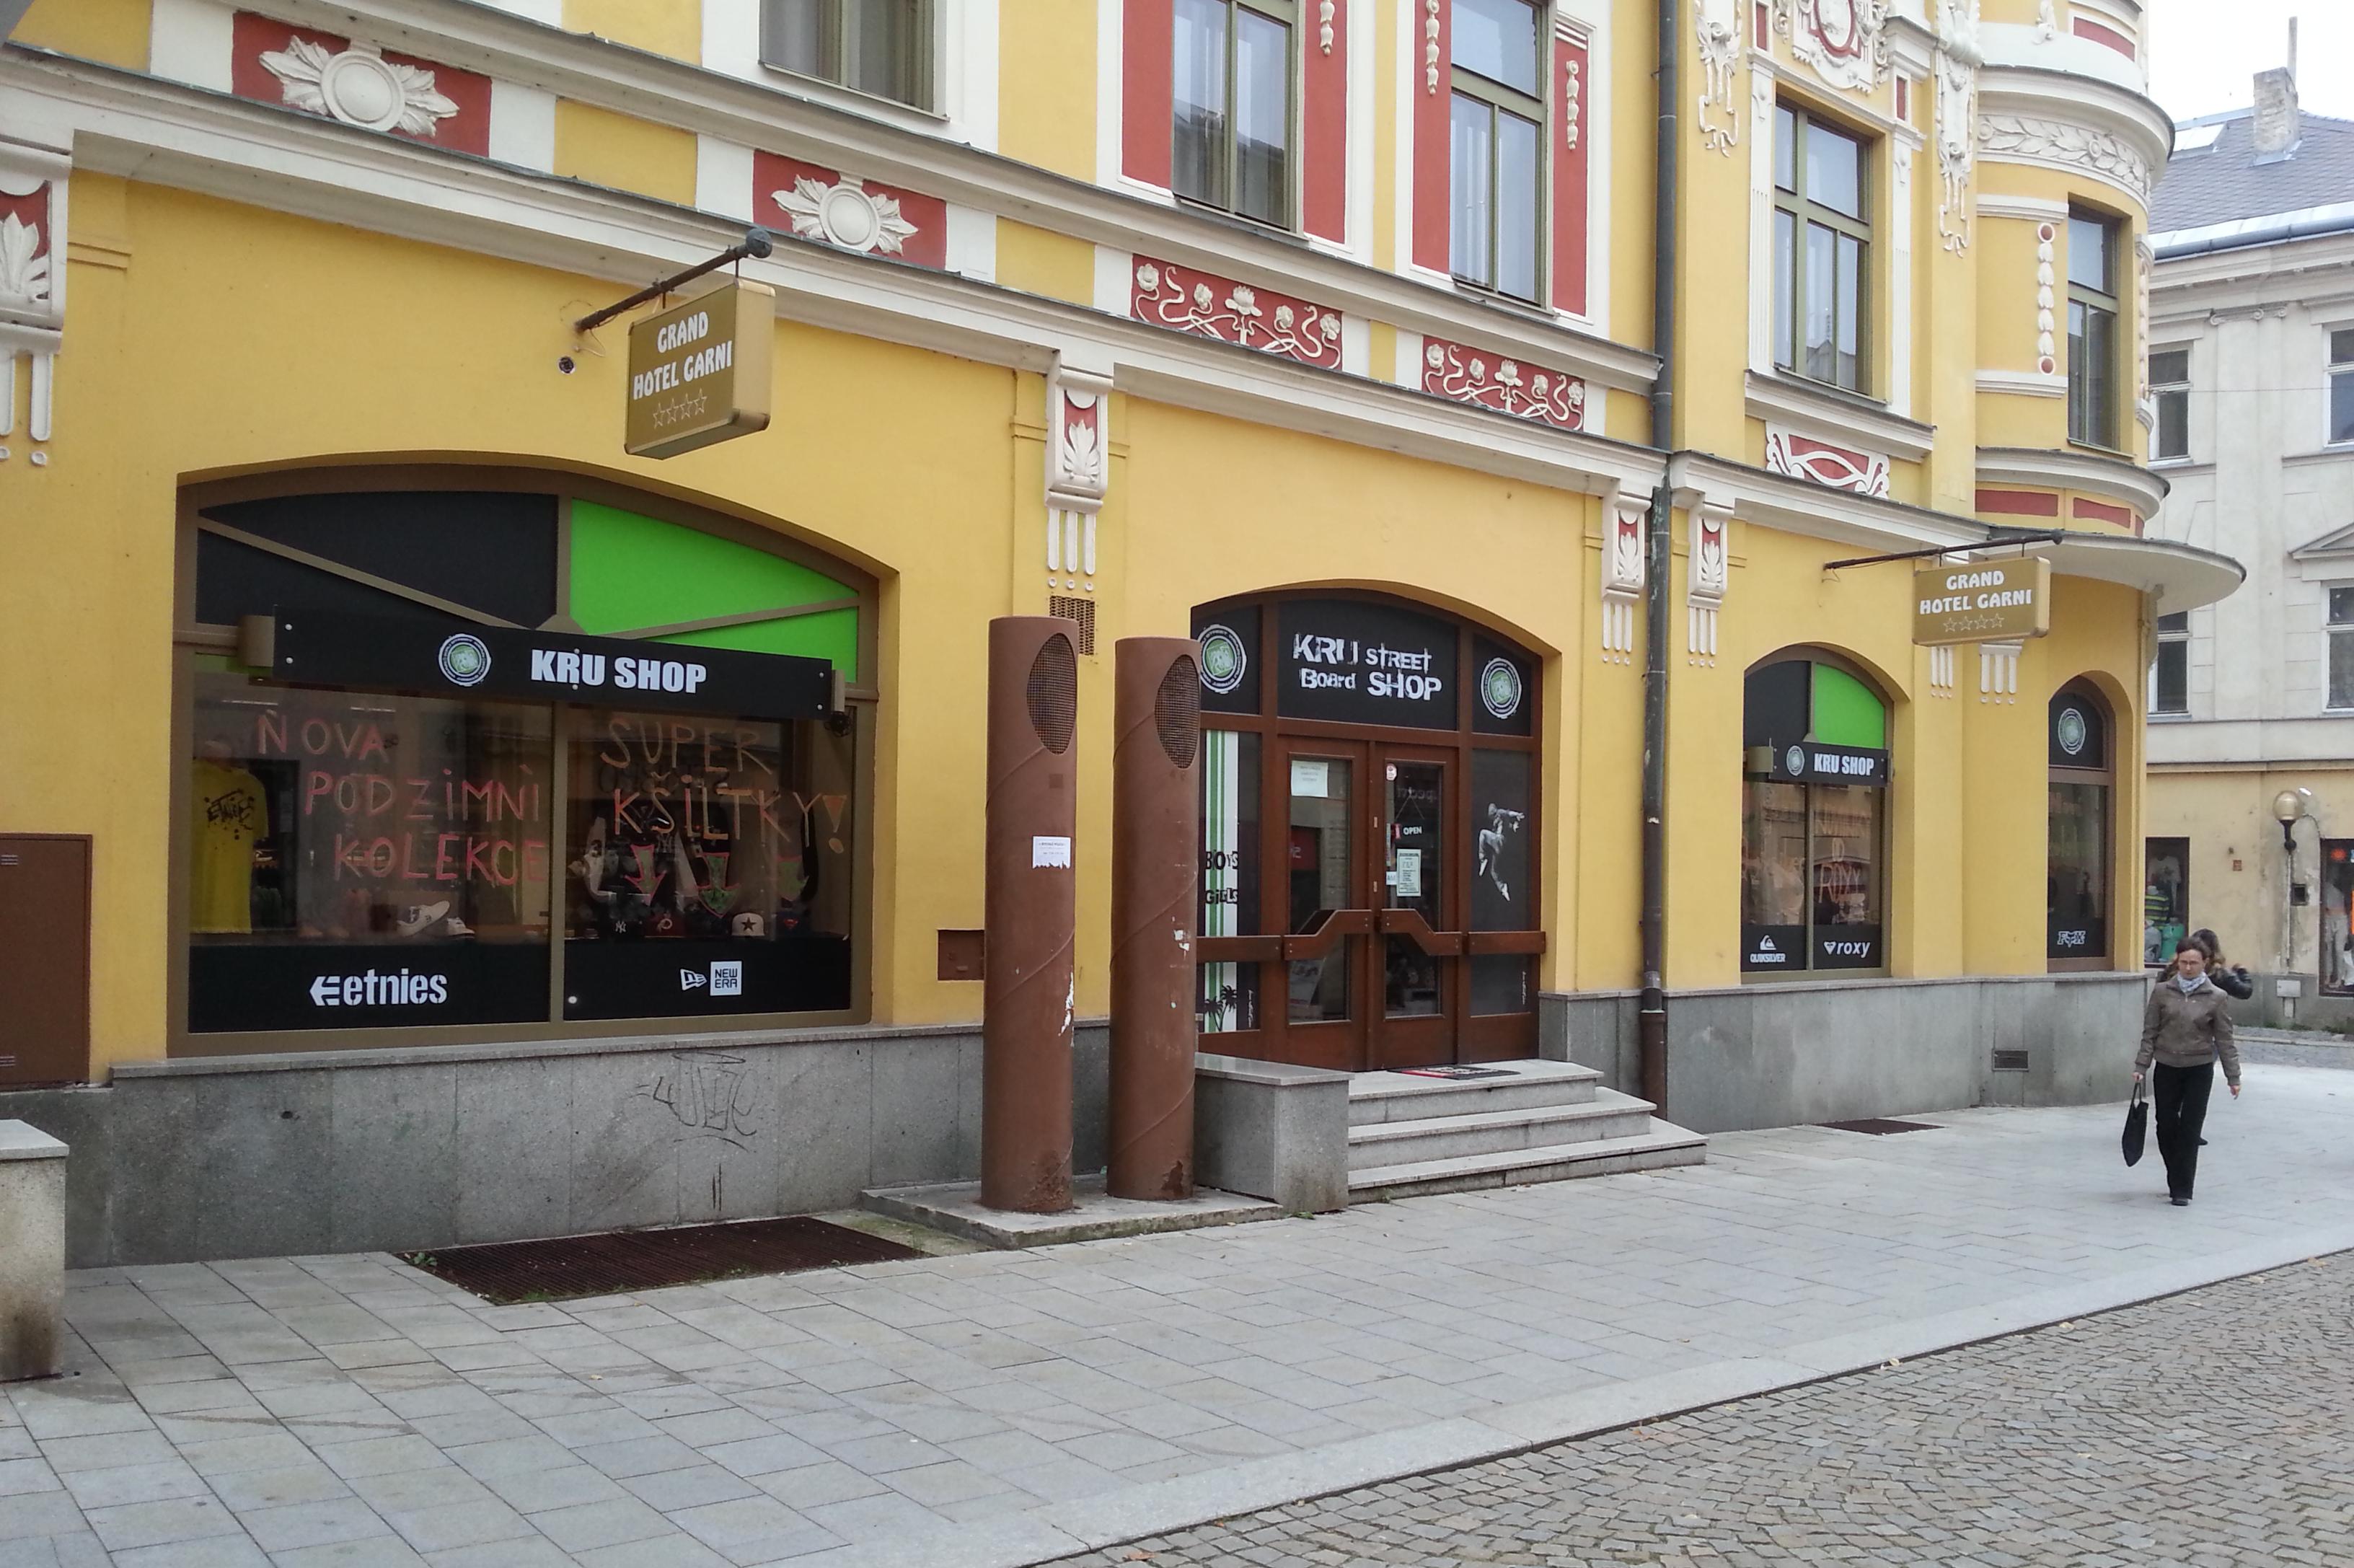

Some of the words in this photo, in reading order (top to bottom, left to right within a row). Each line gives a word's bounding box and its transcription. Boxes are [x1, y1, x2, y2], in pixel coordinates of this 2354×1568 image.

[657, 312, 709, 353] GRAND
[633, 361, 679, 400] HOTEL
[684, 340, 733, 382] GARNI
[1946, 571, 2004, 591] GRAND
[1919, 594, 1972, 615] HOTEL
[1977, 589, 2032, 609] GARNI
[531, 649, 606, 686] KRU
[614, 656, 707, 694] SHOP
[1365, 642, 1432, 674] STREET
[1367, 669, 1442, 701] SHOP
[600, 716, 773, 775] SUPER
[1814, 753, 1840, 774] KRU
[1841, 755, 1874, 776] SHOP
[1403, 826, 1422, 835] OPEN
[1836, 942, 1871, 959] roxy
[343, 968, 448, 1006] etnies
[715, 968, 738, 978] NEW
[715, 979, 738, 989] ERA
